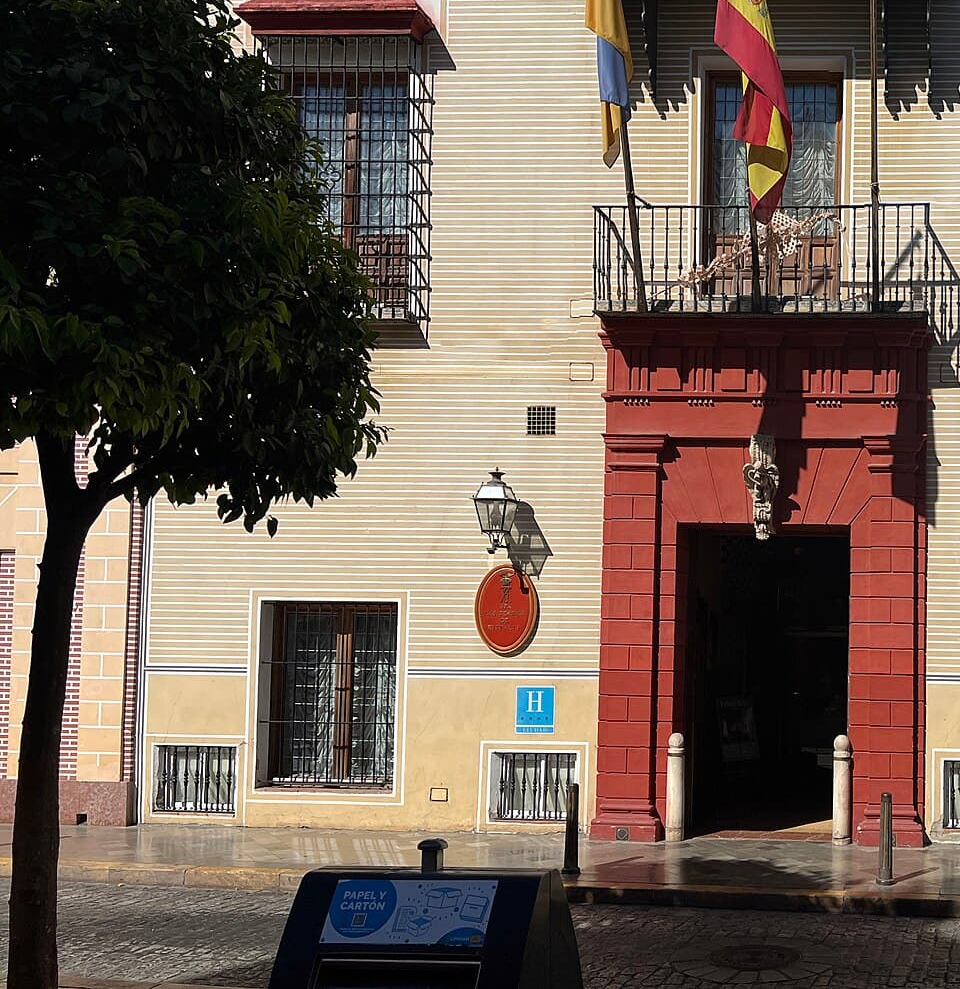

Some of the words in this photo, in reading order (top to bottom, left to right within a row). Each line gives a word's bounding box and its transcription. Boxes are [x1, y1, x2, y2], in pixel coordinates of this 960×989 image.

[525, 690, 545, 713] H
[343, 890, 377, 900] PAPEL
[379, 890, 388, 900] Y
[340, 900, 386, 911] CARTÓN
